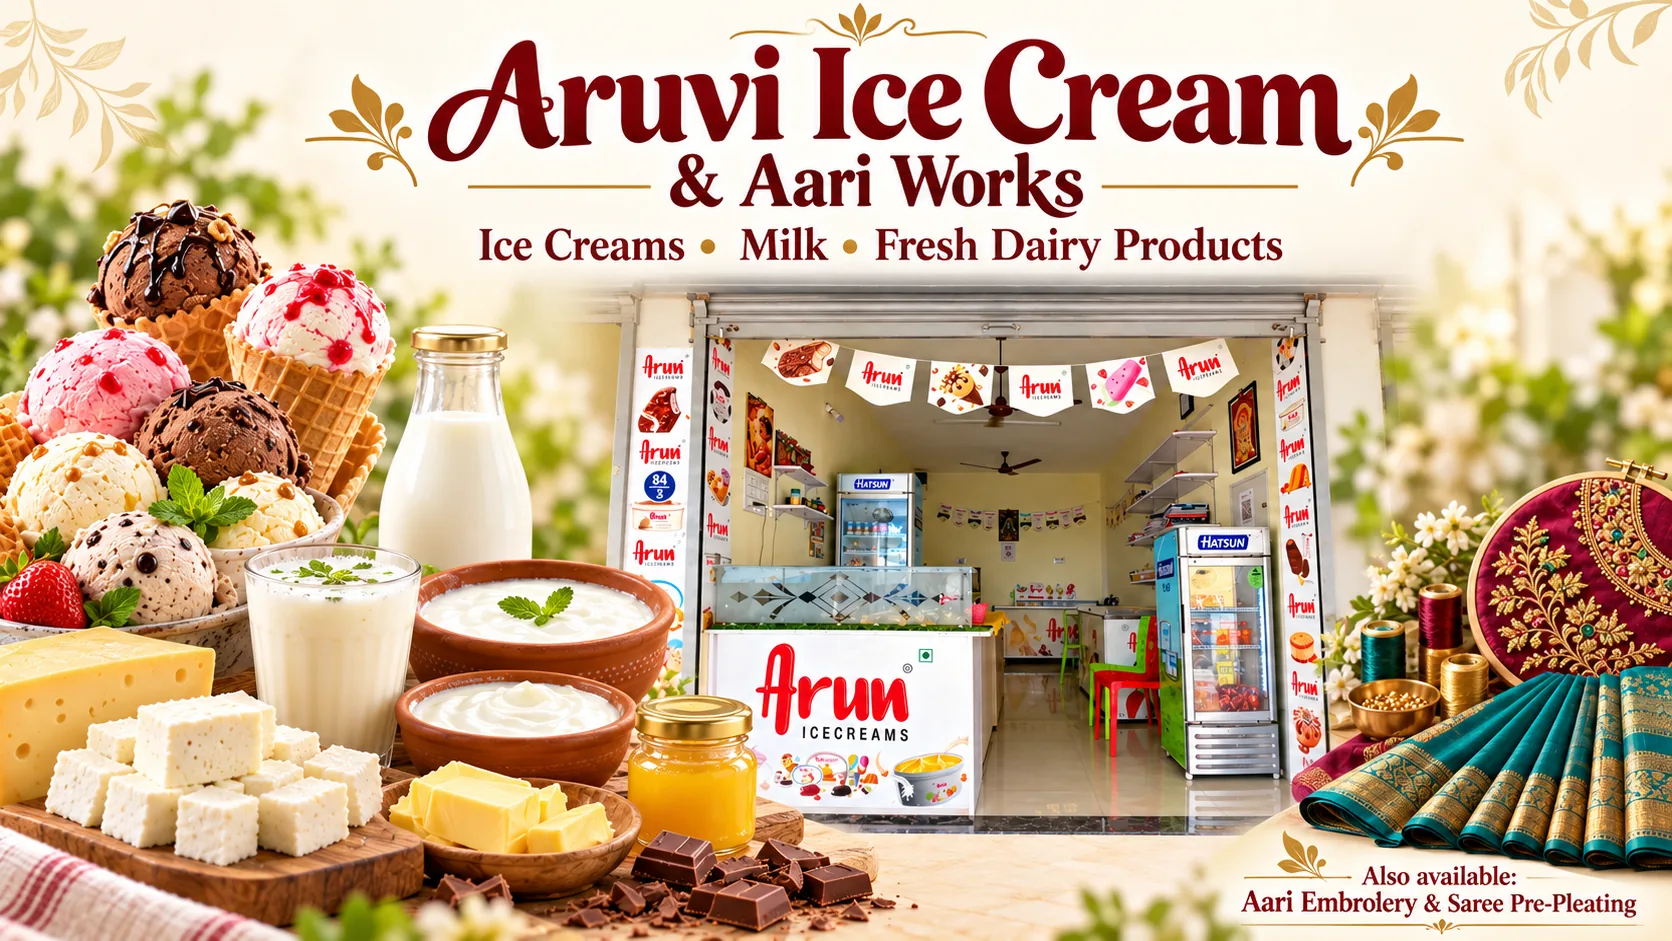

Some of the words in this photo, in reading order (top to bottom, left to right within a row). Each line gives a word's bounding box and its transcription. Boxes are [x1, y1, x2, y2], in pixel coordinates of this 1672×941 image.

[642, 355, 684, 378] Arun
[862, 361, 903, 386] Arun
[1177, 356, 1221, 380] Arun
[1020, 374, 1062, 399] Arun
[639, 439, 681, 464] Arun
[651, 473, 668, 486] 84
[856, 479, 889, 489] HATSUN
[1283, 504, 1310, 529] Arun
[633, 539, 675, 565] Arun
[1200, 536, 1245, 549] HATSUN
[1287, 592, 1315, 618] Arun
[755, 642, 910, 736] Arun
[1291, 670, 1319, 696] Arun
[802, 726, 909, 742] ICECREAMS
